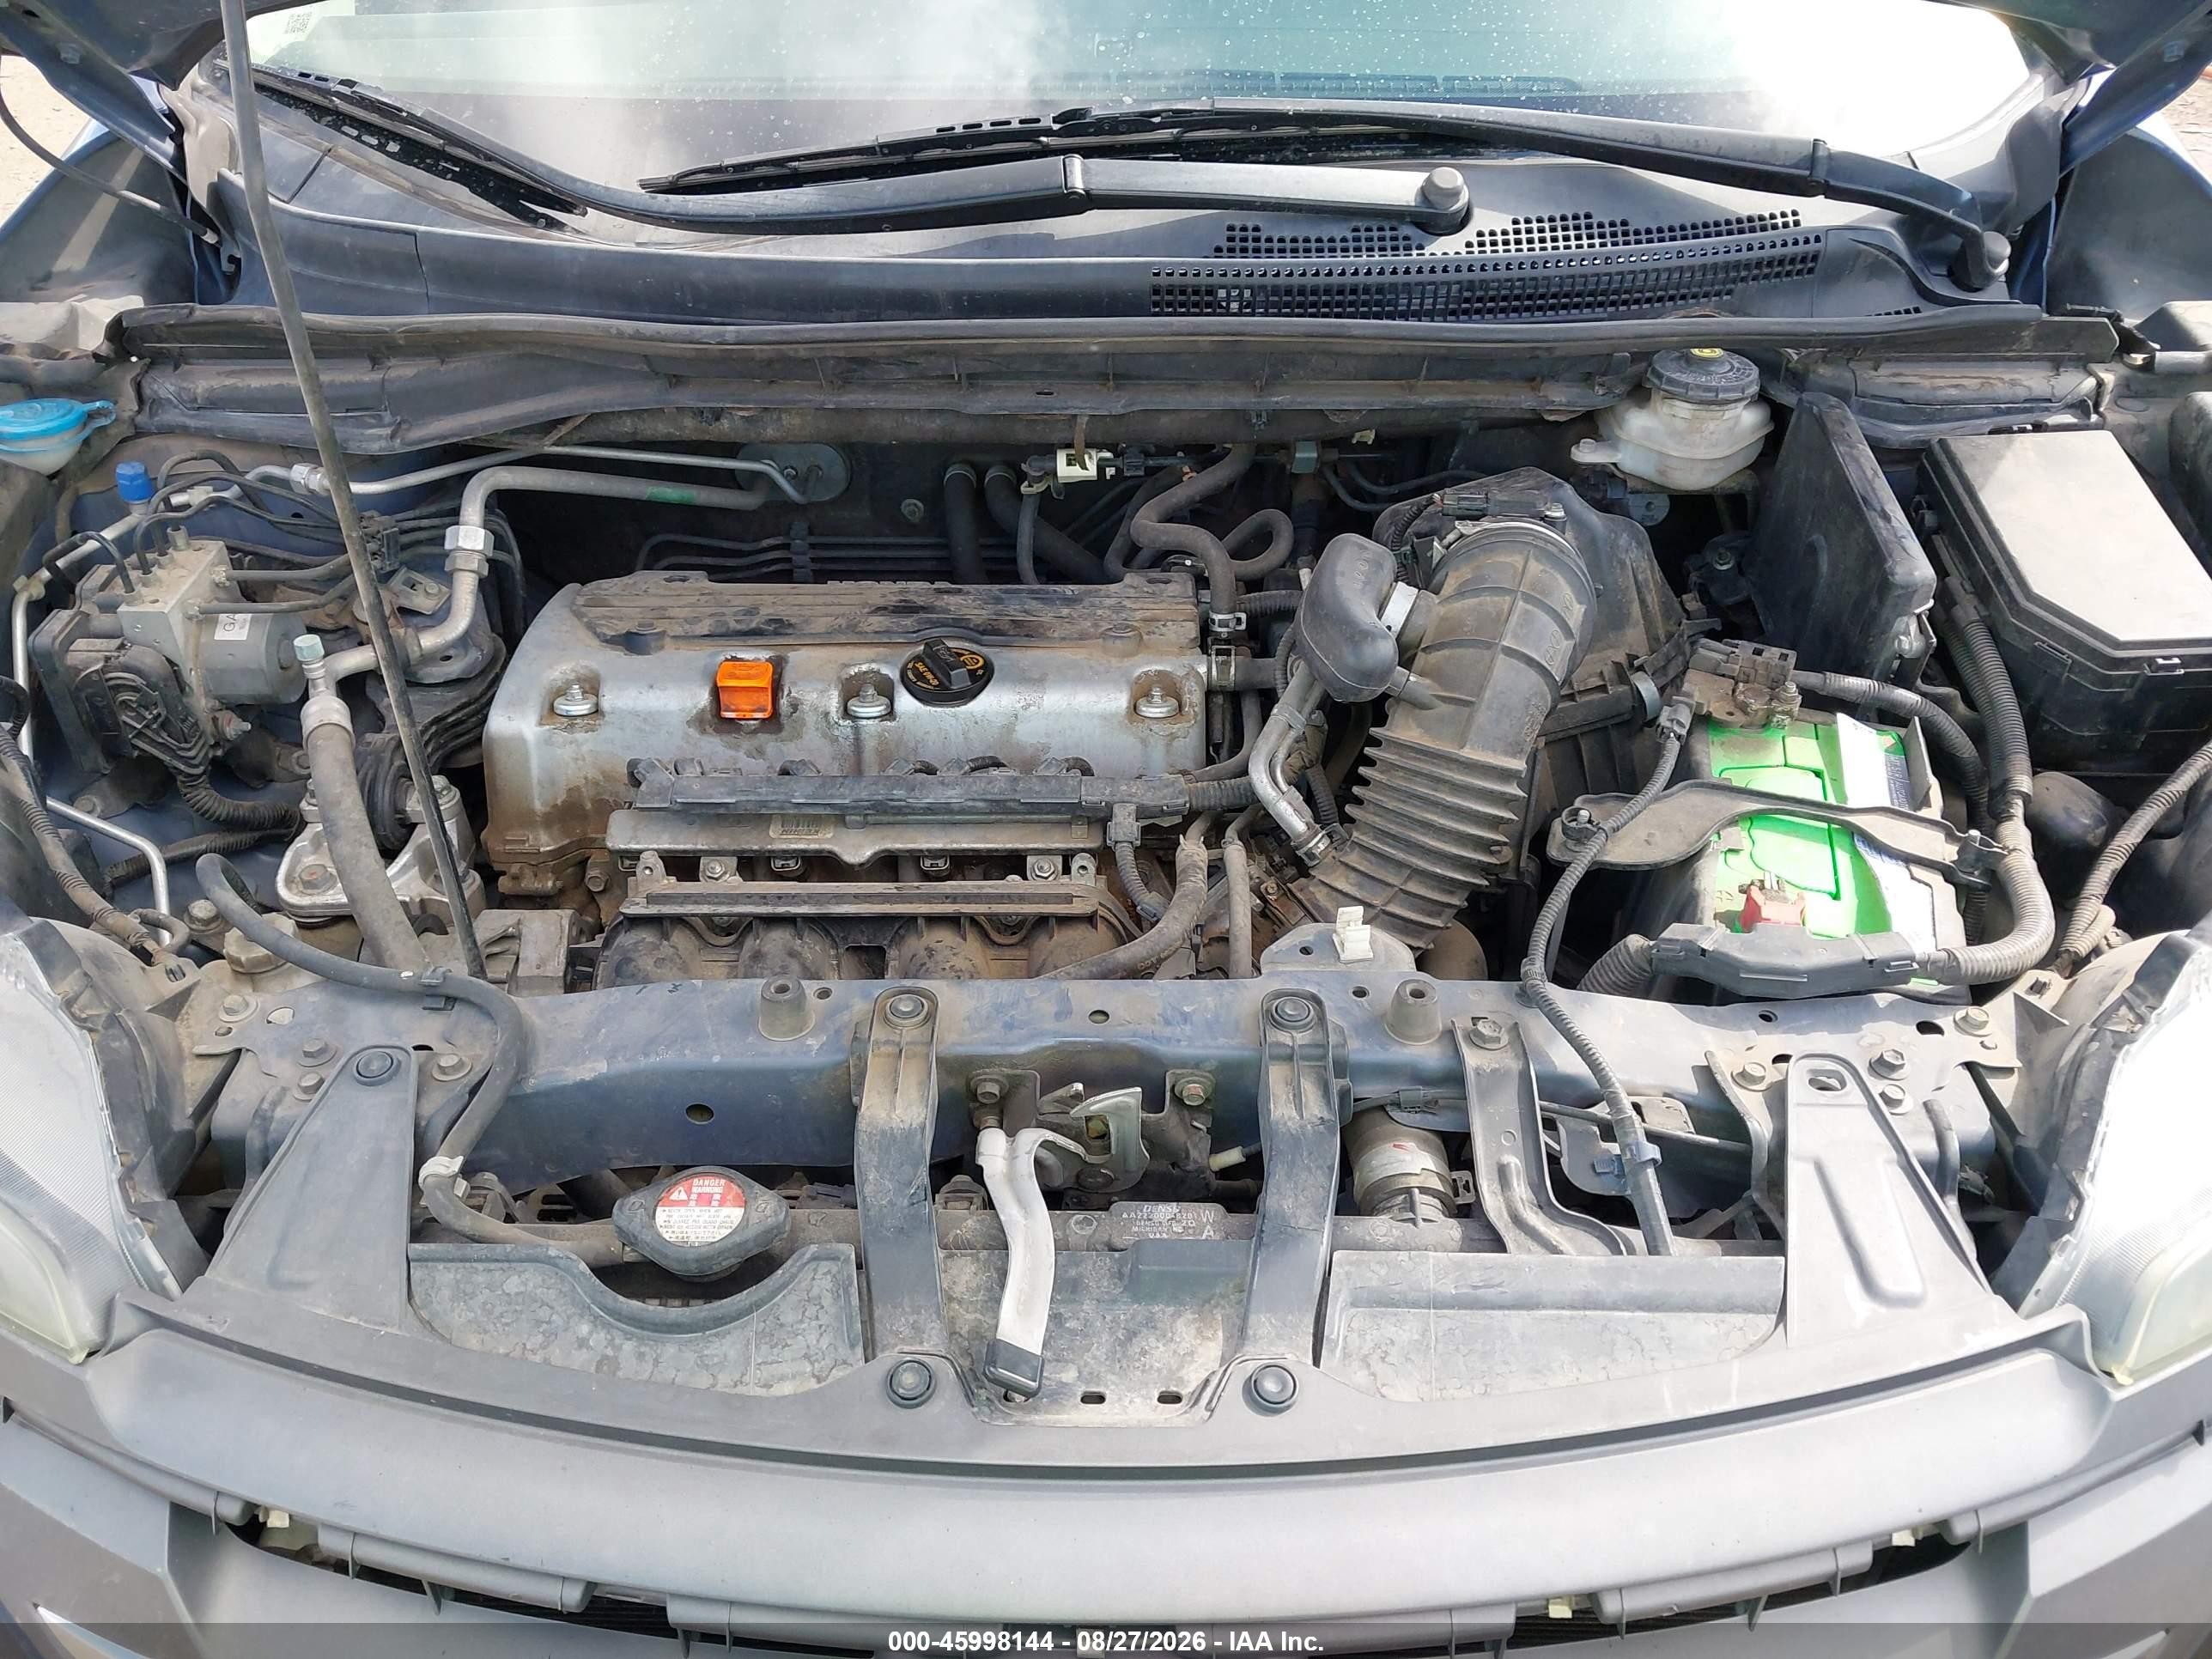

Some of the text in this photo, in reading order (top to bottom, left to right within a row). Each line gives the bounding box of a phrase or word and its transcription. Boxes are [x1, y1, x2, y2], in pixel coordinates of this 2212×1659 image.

[1143, 1204, 1181, 1212] DENSO
[1201, 1210, 1214, 1224] W
[1202, 1225, 1214, 1239] A
